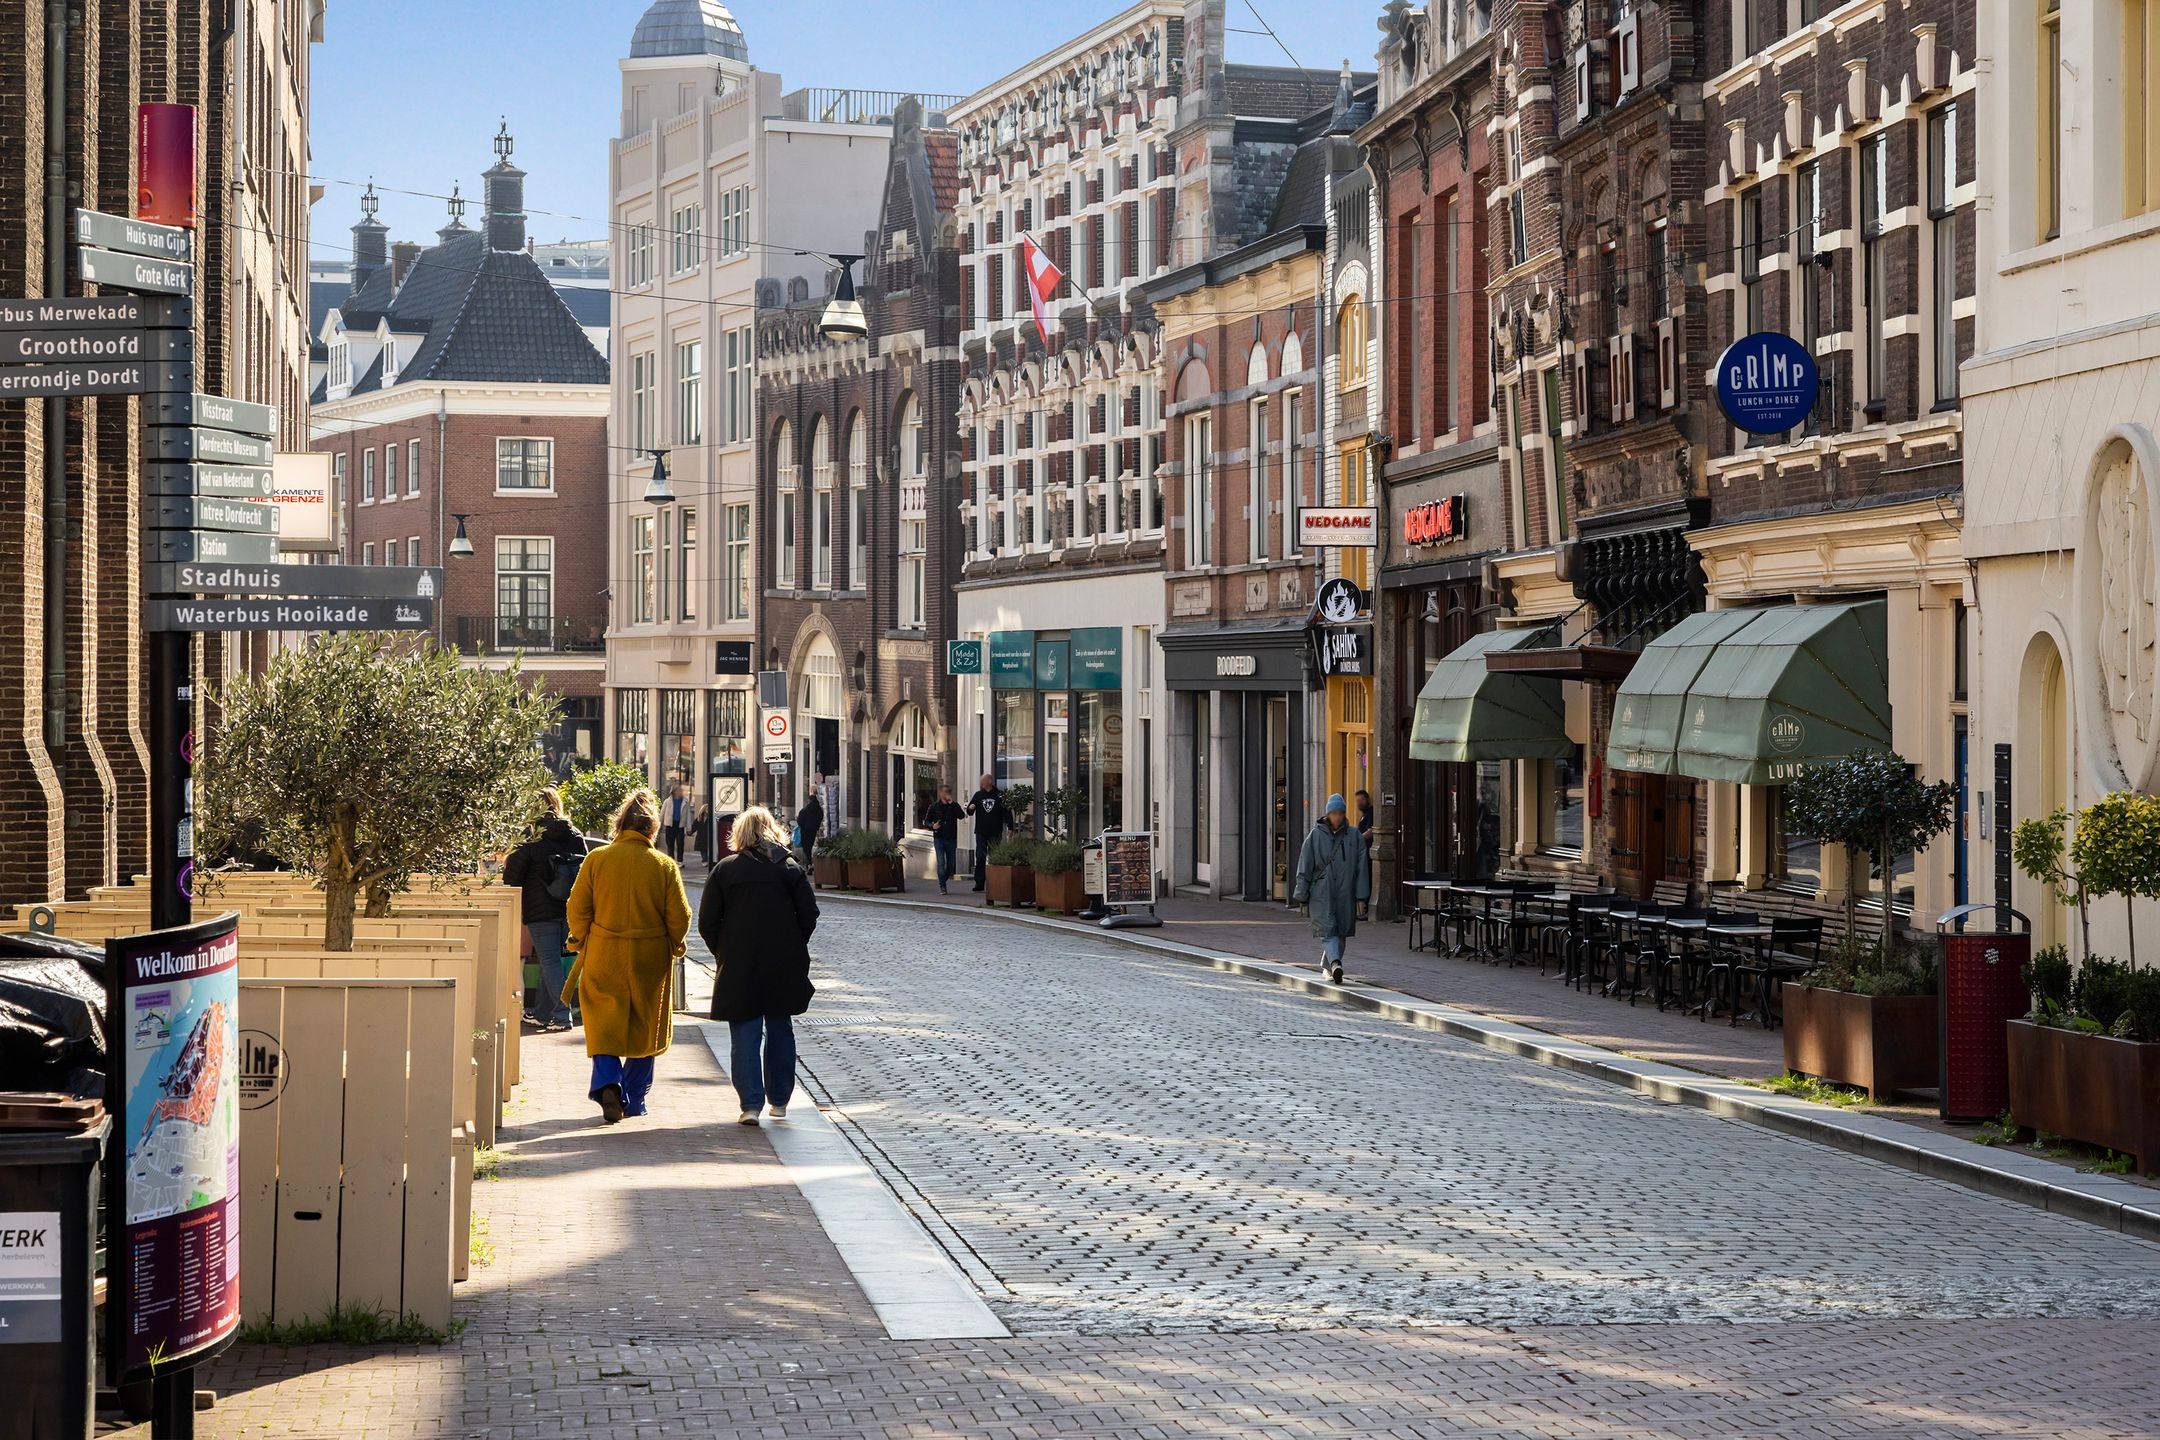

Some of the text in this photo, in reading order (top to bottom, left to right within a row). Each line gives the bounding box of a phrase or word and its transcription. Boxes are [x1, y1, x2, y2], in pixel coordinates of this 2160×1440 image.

[126, 225, 186, 255] Huis van Gijn
[135, 264, 187, 288] Grote Kerk
[39, 304, 138, 321] Merwekade
[19, 336, 139, 356] Groothoofd
[87, 368, 140, 386] Dordt
[1738, 396, 1763, 407] LUNCH
[1775, 395, 1800, 405] DINER
[201, 400, 233, 422] Visstraat
[199, 435, 259, 457] Dordrechts Museum
[200, 470, 254, 489] Hof van Nederland
[271, 495, 324, 503] GRENZE
[200, 502, 262, 526] Intree Dordrecht
[1304, 515, 1372, 529] NEDGAME
[1404, 497, 1453, 545] NEDGAME
[200, 537, 227, 556] Station
[181, 567, 281, 588] Stadhuis
[175, 606, 369, 623] Waterbus Hooikade
[955, 649, 975, 658] Mode
[956, 657, 974, 666] & Zo
[1768, 763, 1806, 780] LUNC
[136, 951, 196, 978] Welkom
[198, 947, 209, 970] in
